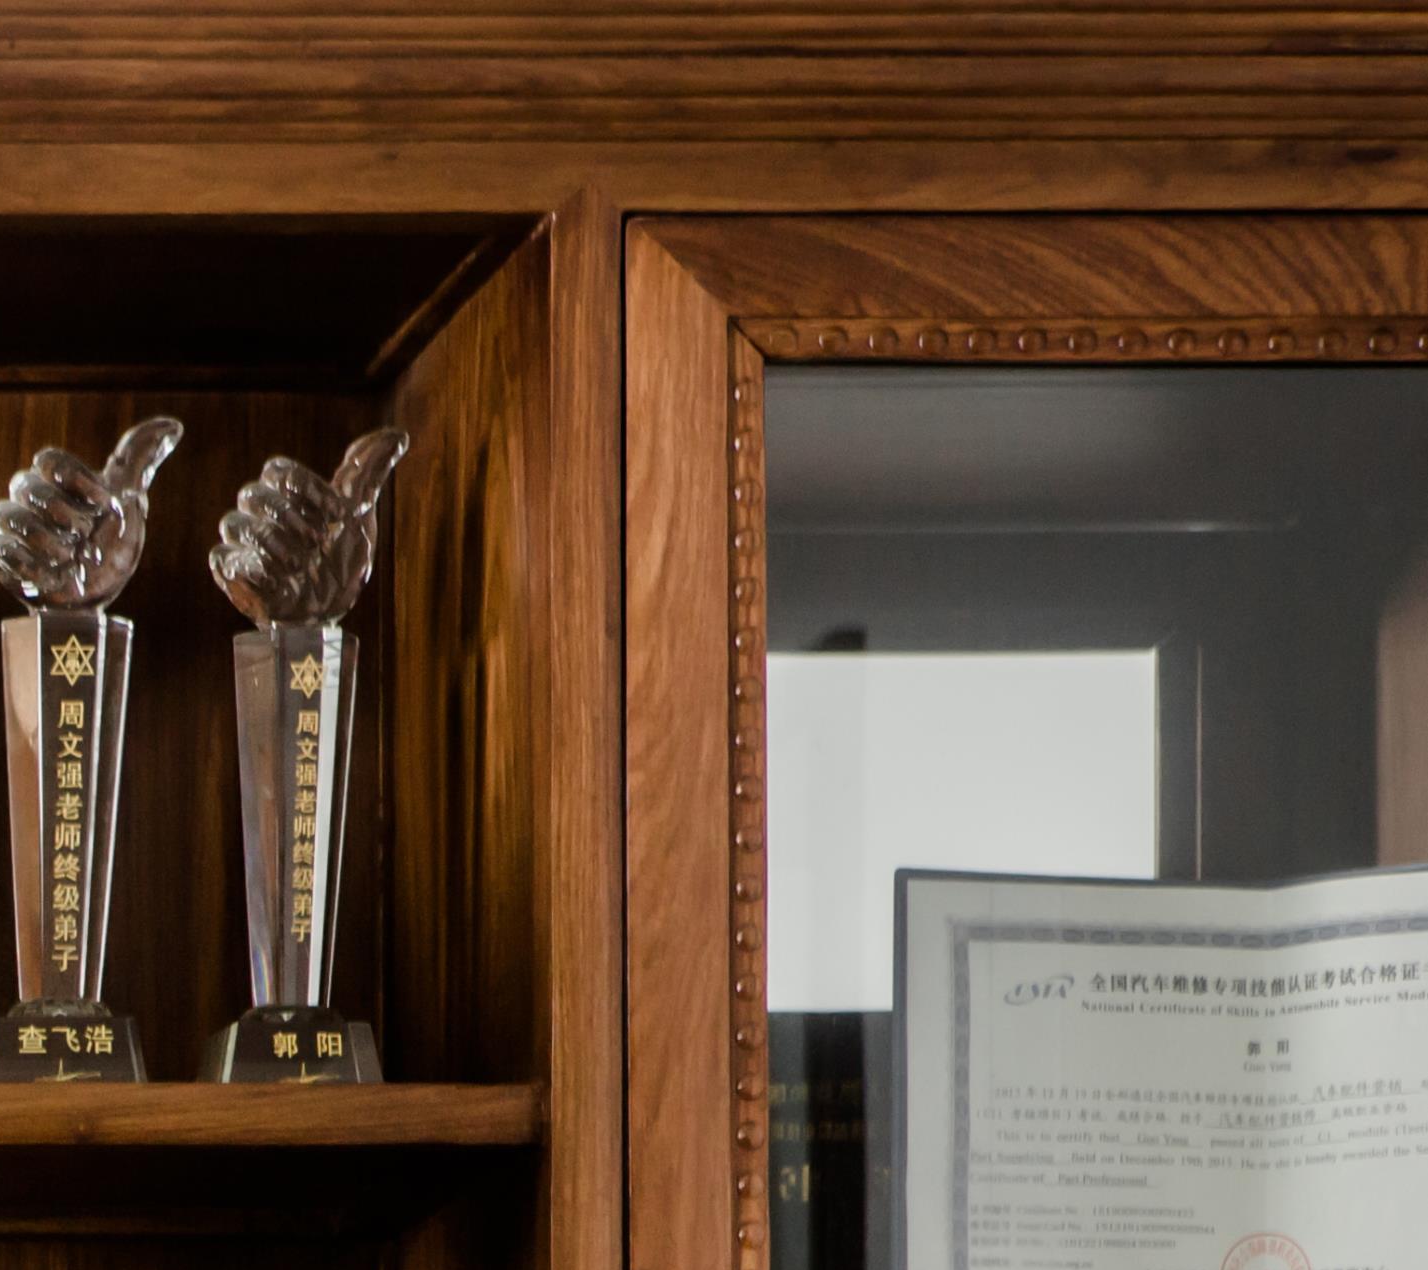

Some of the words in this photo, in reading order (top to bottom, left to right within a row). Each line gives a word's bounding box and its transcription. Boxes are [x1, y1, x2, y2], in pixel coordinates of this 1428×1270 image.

[51, 699, 85, 973] 周文强老师终级弟子
[289, 710, 320, 943] 周文强老师终级弟子
[17, 1024, 115, 1056] 查飞浩
